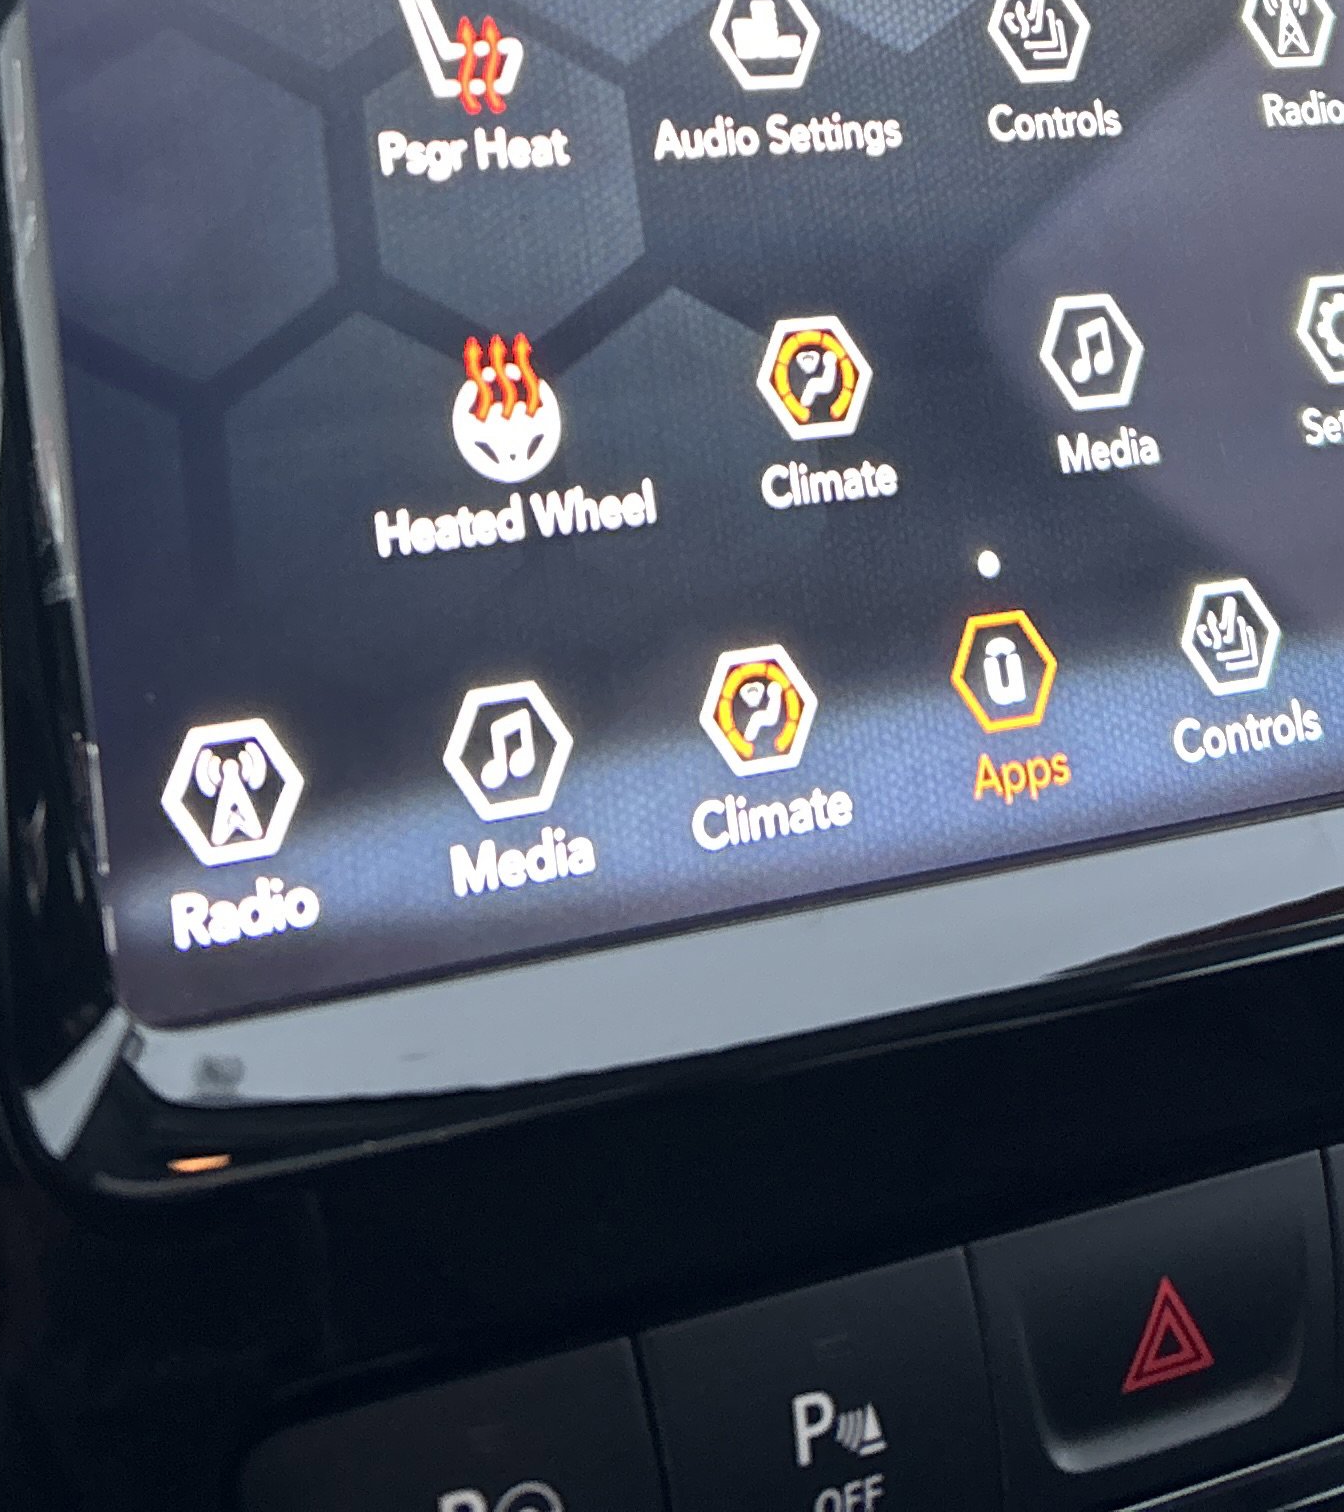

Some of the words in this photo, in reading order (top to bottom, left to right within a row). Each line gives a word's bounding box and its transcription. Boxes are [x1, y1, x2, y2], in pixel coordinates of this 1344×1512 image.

[653, 114, 760, 161] Audio
[765, 111, 903, 157] Settings
[987, 97, 1123, 143] Controls
[377, 130, 469, 182] Psgr
[473, 126, 572, 171] Heat
[1056, 425, 1161, 474] Media
[760, 459, 898, 510] Climate
[374, 492, 526, 558] Heated
[530, 478, 658, 538] Wheel
[1173, 700, 1323, 765] Controls
[973, 751, 1072, 806] Apps
[691, 787, 853, 852] Climate
[449, 826, 597, 898] Media
[170, 877, 320, 952] Radio
[793, 1392, 834, 1466] P
[815, 1473, 883, 1512] OFF
